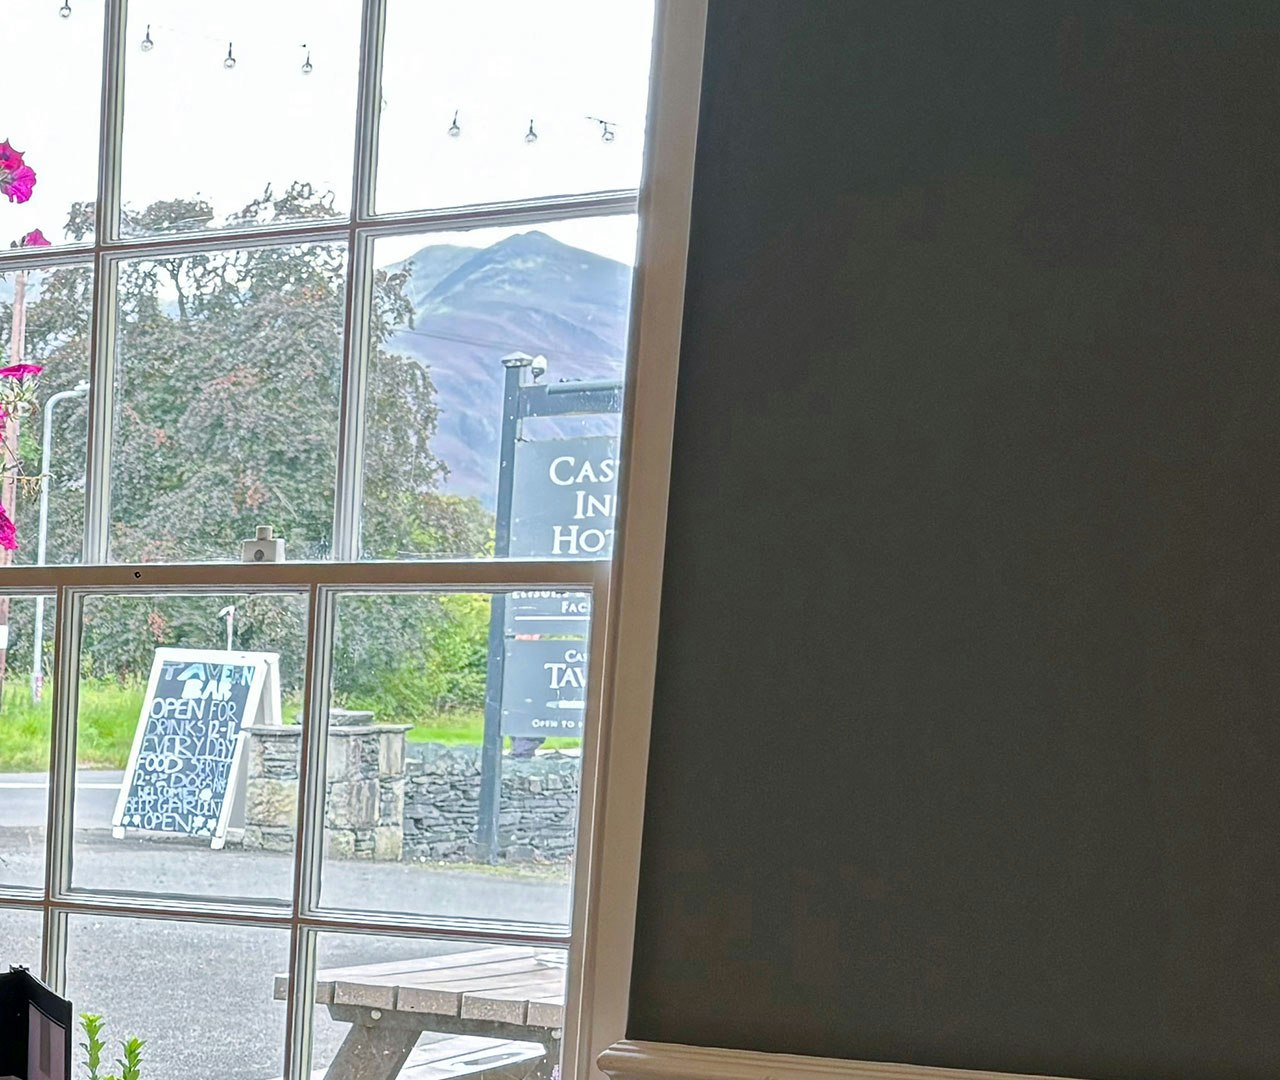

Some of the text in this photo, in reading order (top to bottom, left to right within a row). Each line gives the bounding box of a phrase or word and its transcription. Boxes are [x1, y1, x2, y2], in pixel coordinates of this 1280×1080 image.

[549, 456, 620, 486] CAS
[561, 601, 588, 613] FAC
[182, 678, 232, 701] BAR
[151, 697, 239, 723] OPEN FOR
[146, 718, 206, 737] DRINKS
[135, 754, 183, 773] FOOD
[171, 772, 212, 789] DOGS
[126, 797, 222, 817] BEER GARDEN
[145, 813, 192, 832] OPEN
